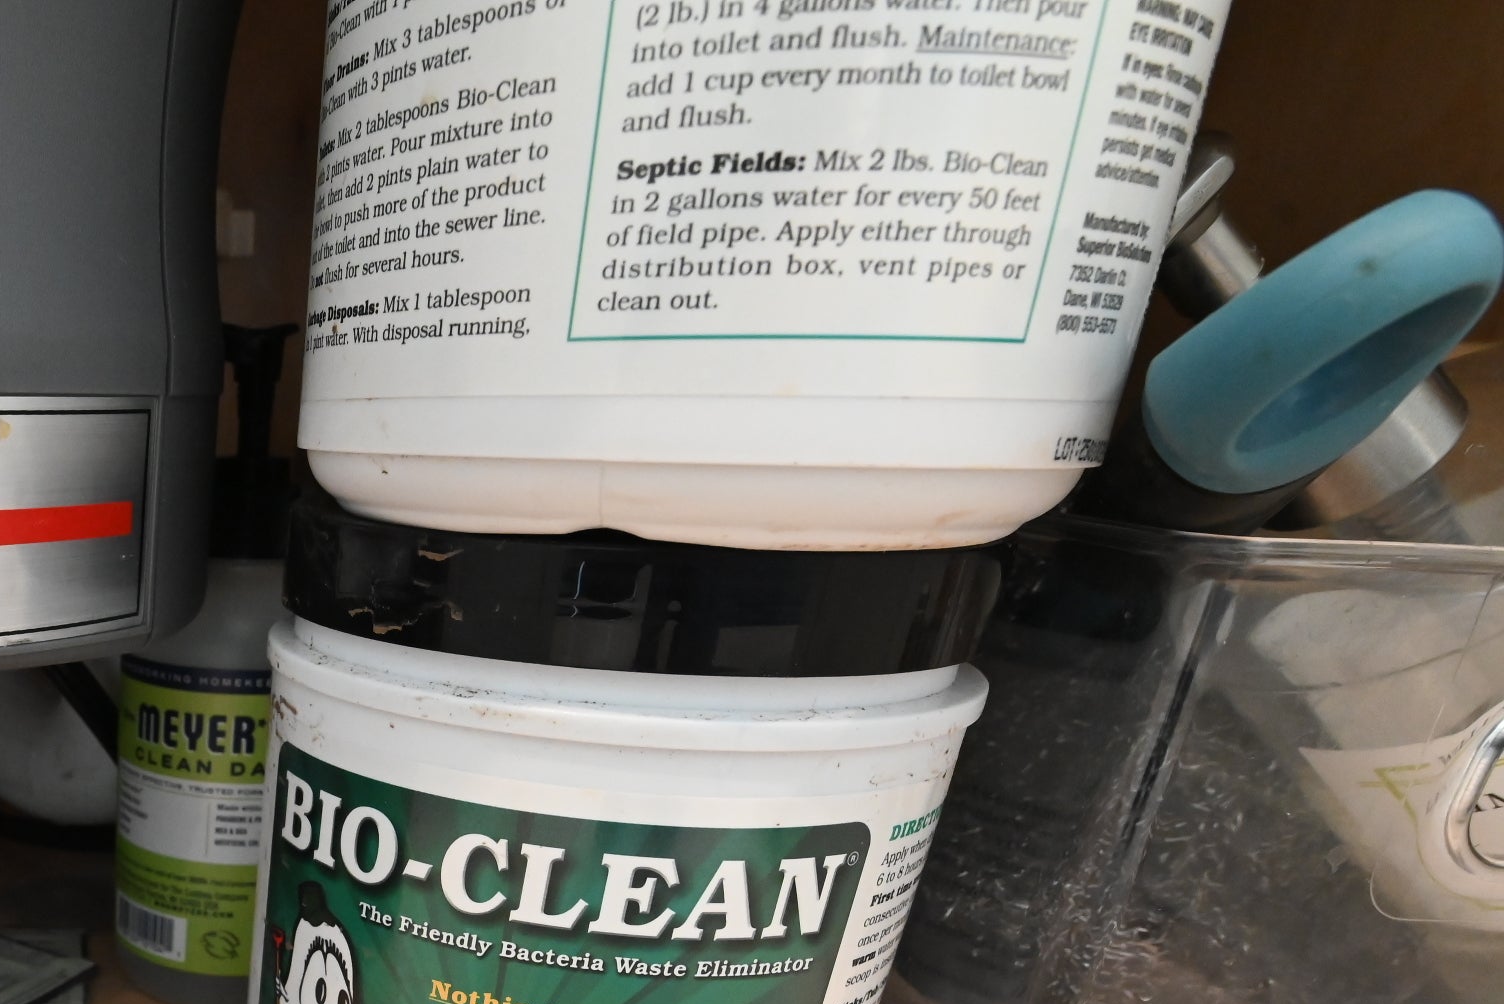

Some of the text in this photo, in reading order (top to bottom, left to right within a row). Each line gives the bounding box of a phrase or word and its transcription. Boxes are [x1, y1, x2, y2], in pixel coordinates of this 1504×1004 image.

[632, 24, 1078, 63] into toilet and flush. Maintenance:
[627, 61, 1070, 98] add 1 cup every month to toilet bowl
[337, 77, 556, 150] Mix 2 tablespoons Bio-Clean
[622, 103, 752, 133] and flush.
[617, 149, 1048, 184] Septic Fields: Mix 2 lbs. Bio-Clean
[611, 184, 1041, 216] in 2 gallons water for every 50 feet
[607, 219, 1031, 251] of field pipe. Apply either through
[602, 255, 1026, 283] distribution box, vent pipes or
[327, 288, 530, 323] Disposals: Mix 1 tablespoon
[597, 290, 718, 311] clean out.
[353, 317, 530, 345] With disposal running,
[135, 748, 265, 777] CLEAN DA
[282, 770, 846, 941] BIO-CLEAN
[359, 901, 813, 978] The Friendly Bacteria Waste Eliminator
